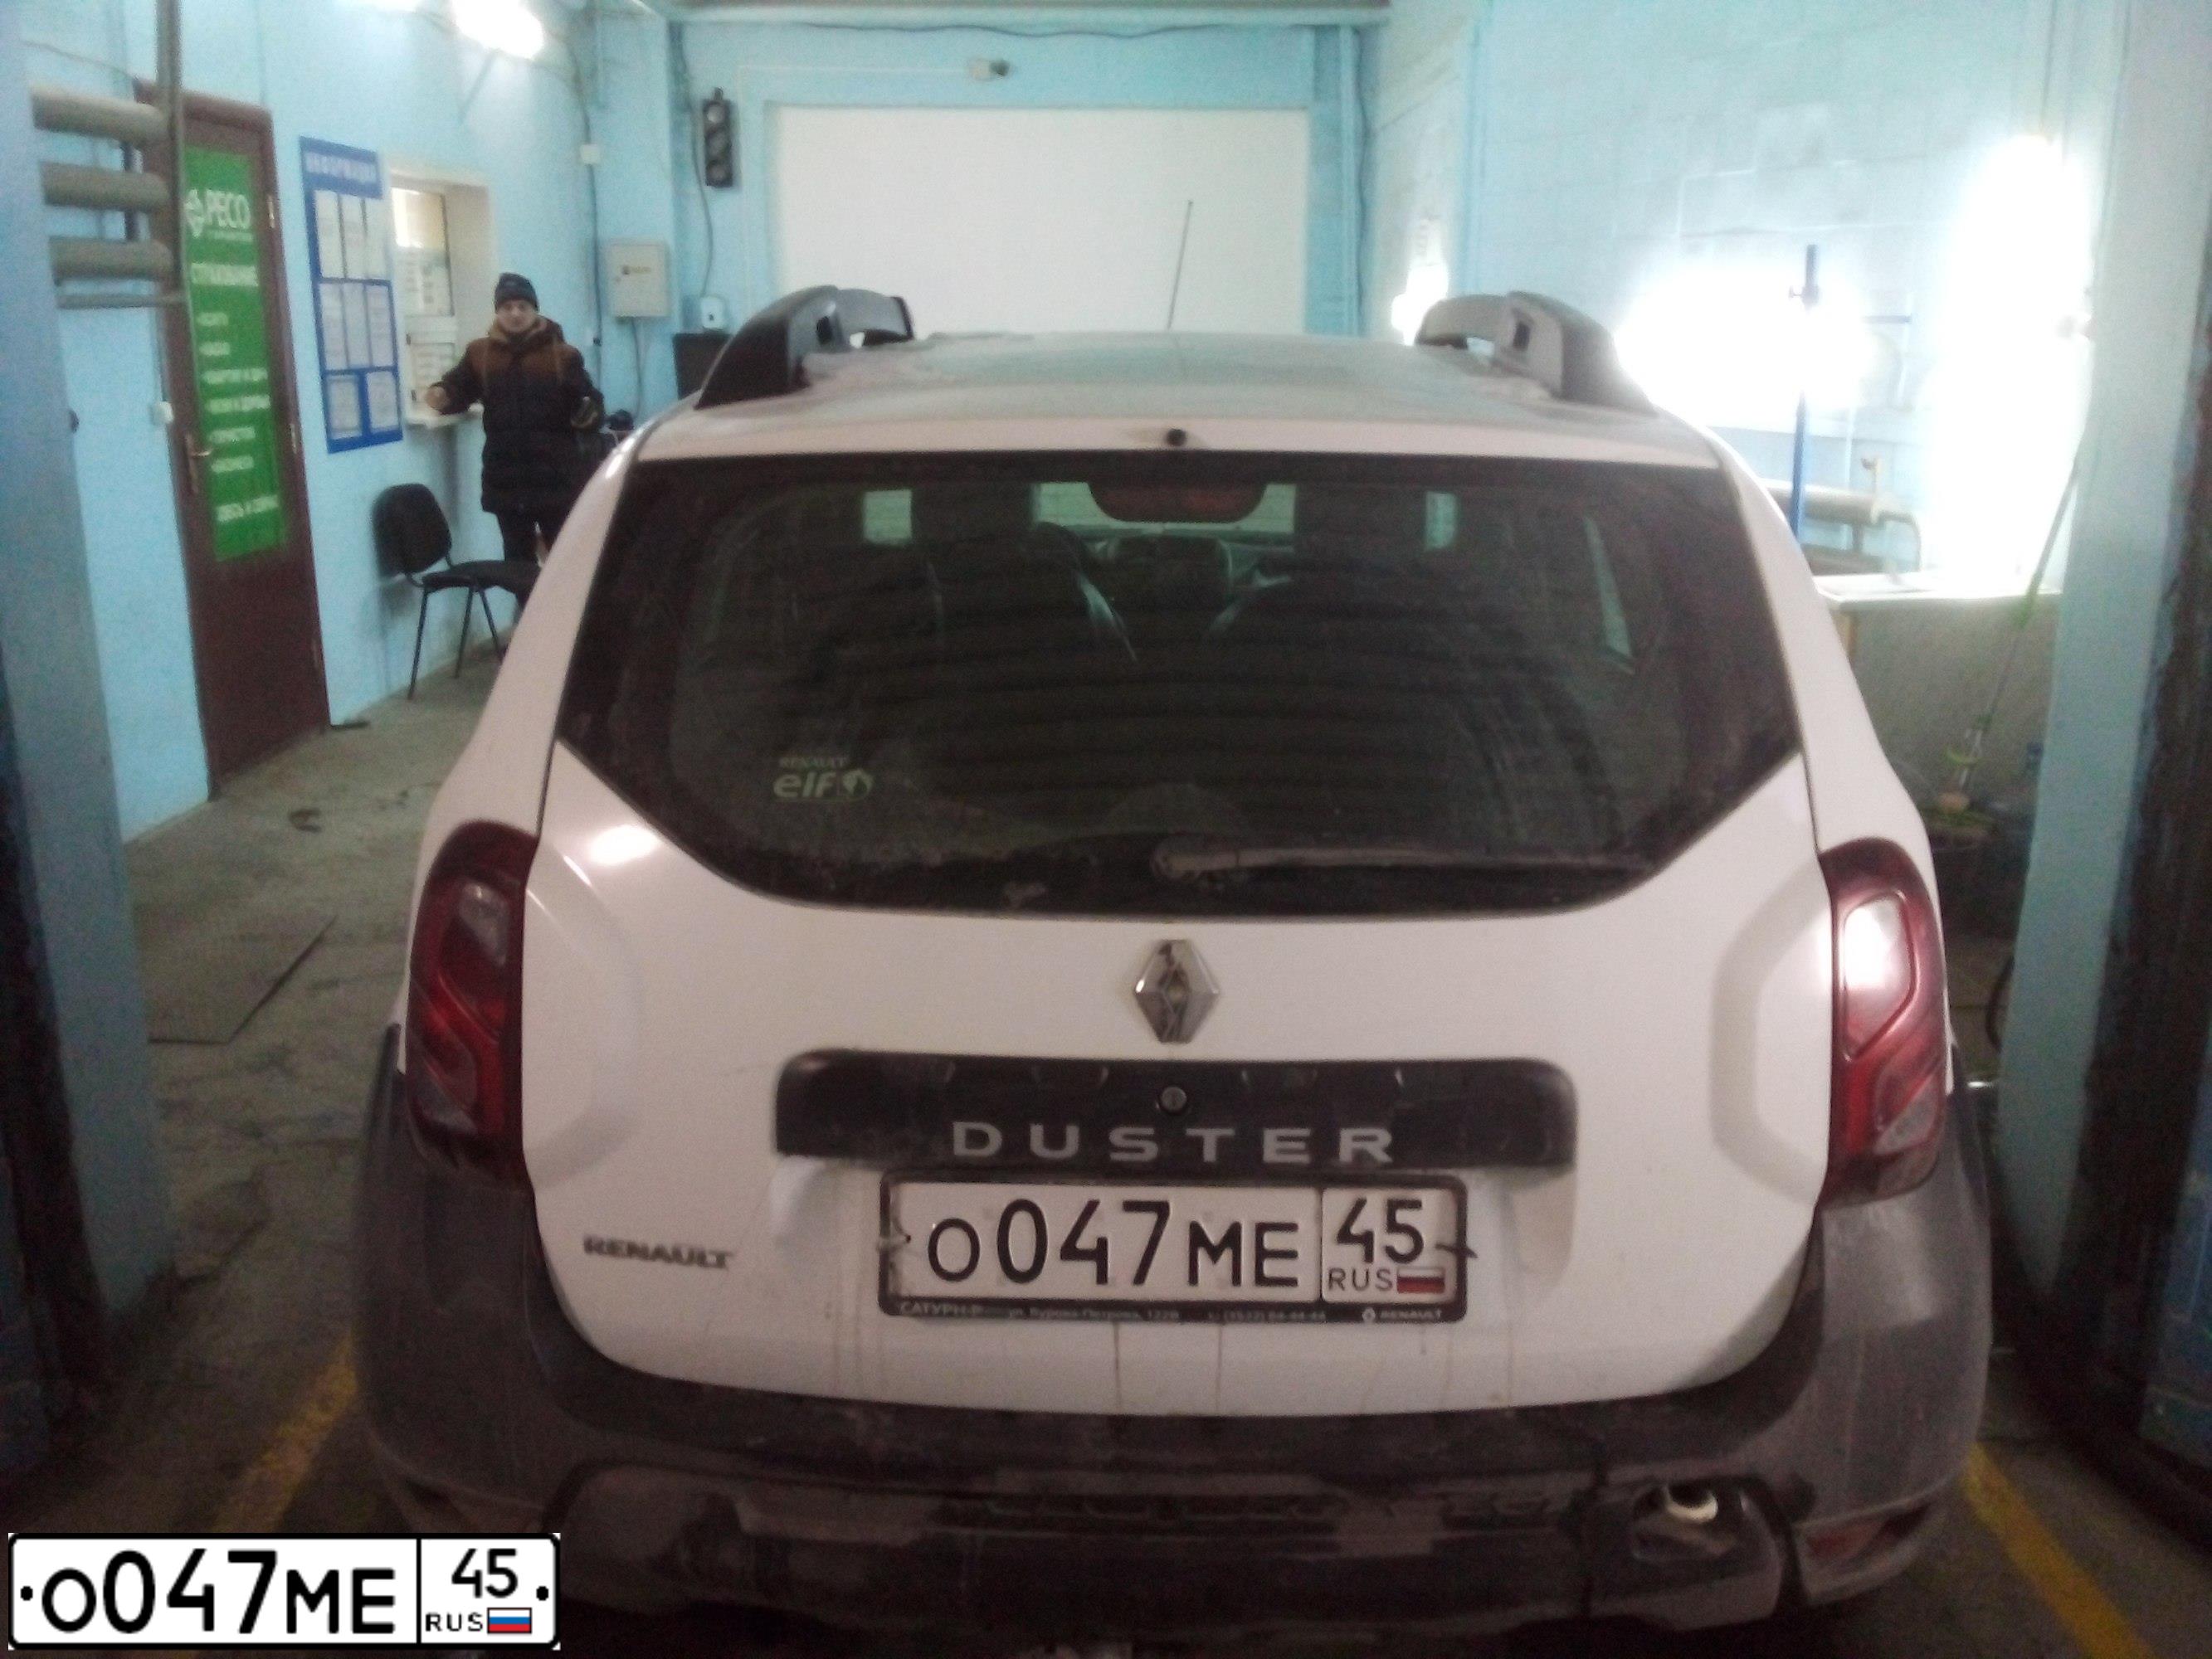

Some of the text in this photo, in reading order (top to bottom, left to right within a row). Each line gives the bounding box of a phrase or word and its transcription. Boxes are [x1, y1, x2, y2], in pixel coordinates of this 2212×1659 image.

[952, 1121, 1394, 1164] DUSTER
[1336, 1197, 1425, 1263] 45
[582, 1235, 735, 1270] RENAULT
[1328, 1267, 1393, 1292] RUS
